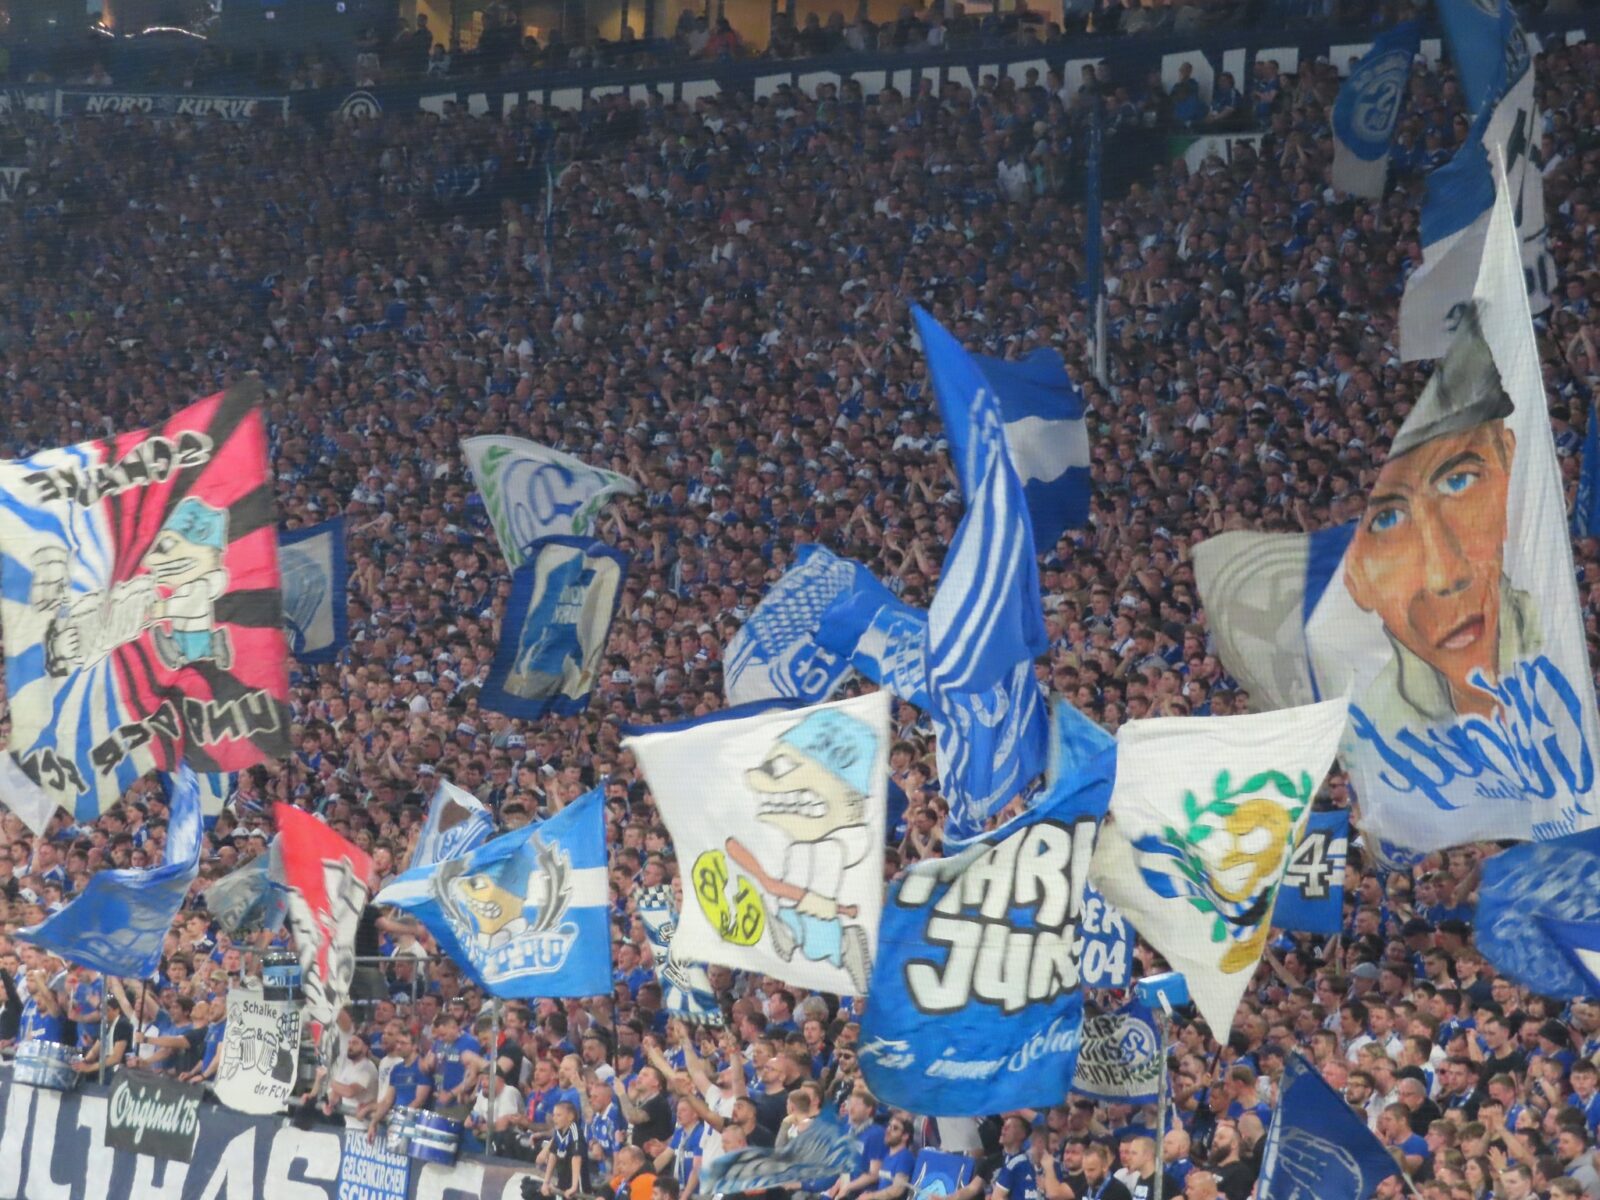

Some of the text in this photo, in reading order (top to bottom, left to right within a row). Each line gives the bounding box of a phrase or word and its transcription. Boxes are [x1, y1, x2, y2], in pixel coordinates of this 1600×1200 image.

[86, 97, 153, 115] NORD
[242, 1001, 278, 1020] Schalke
[257, 1028, 264, 1040] &
[254, 1083, 291, 1099] der FCN
[109, 1080, 182, 1144] Original
[342, 1155, 407, 1194] GELSENKIRCHEN
